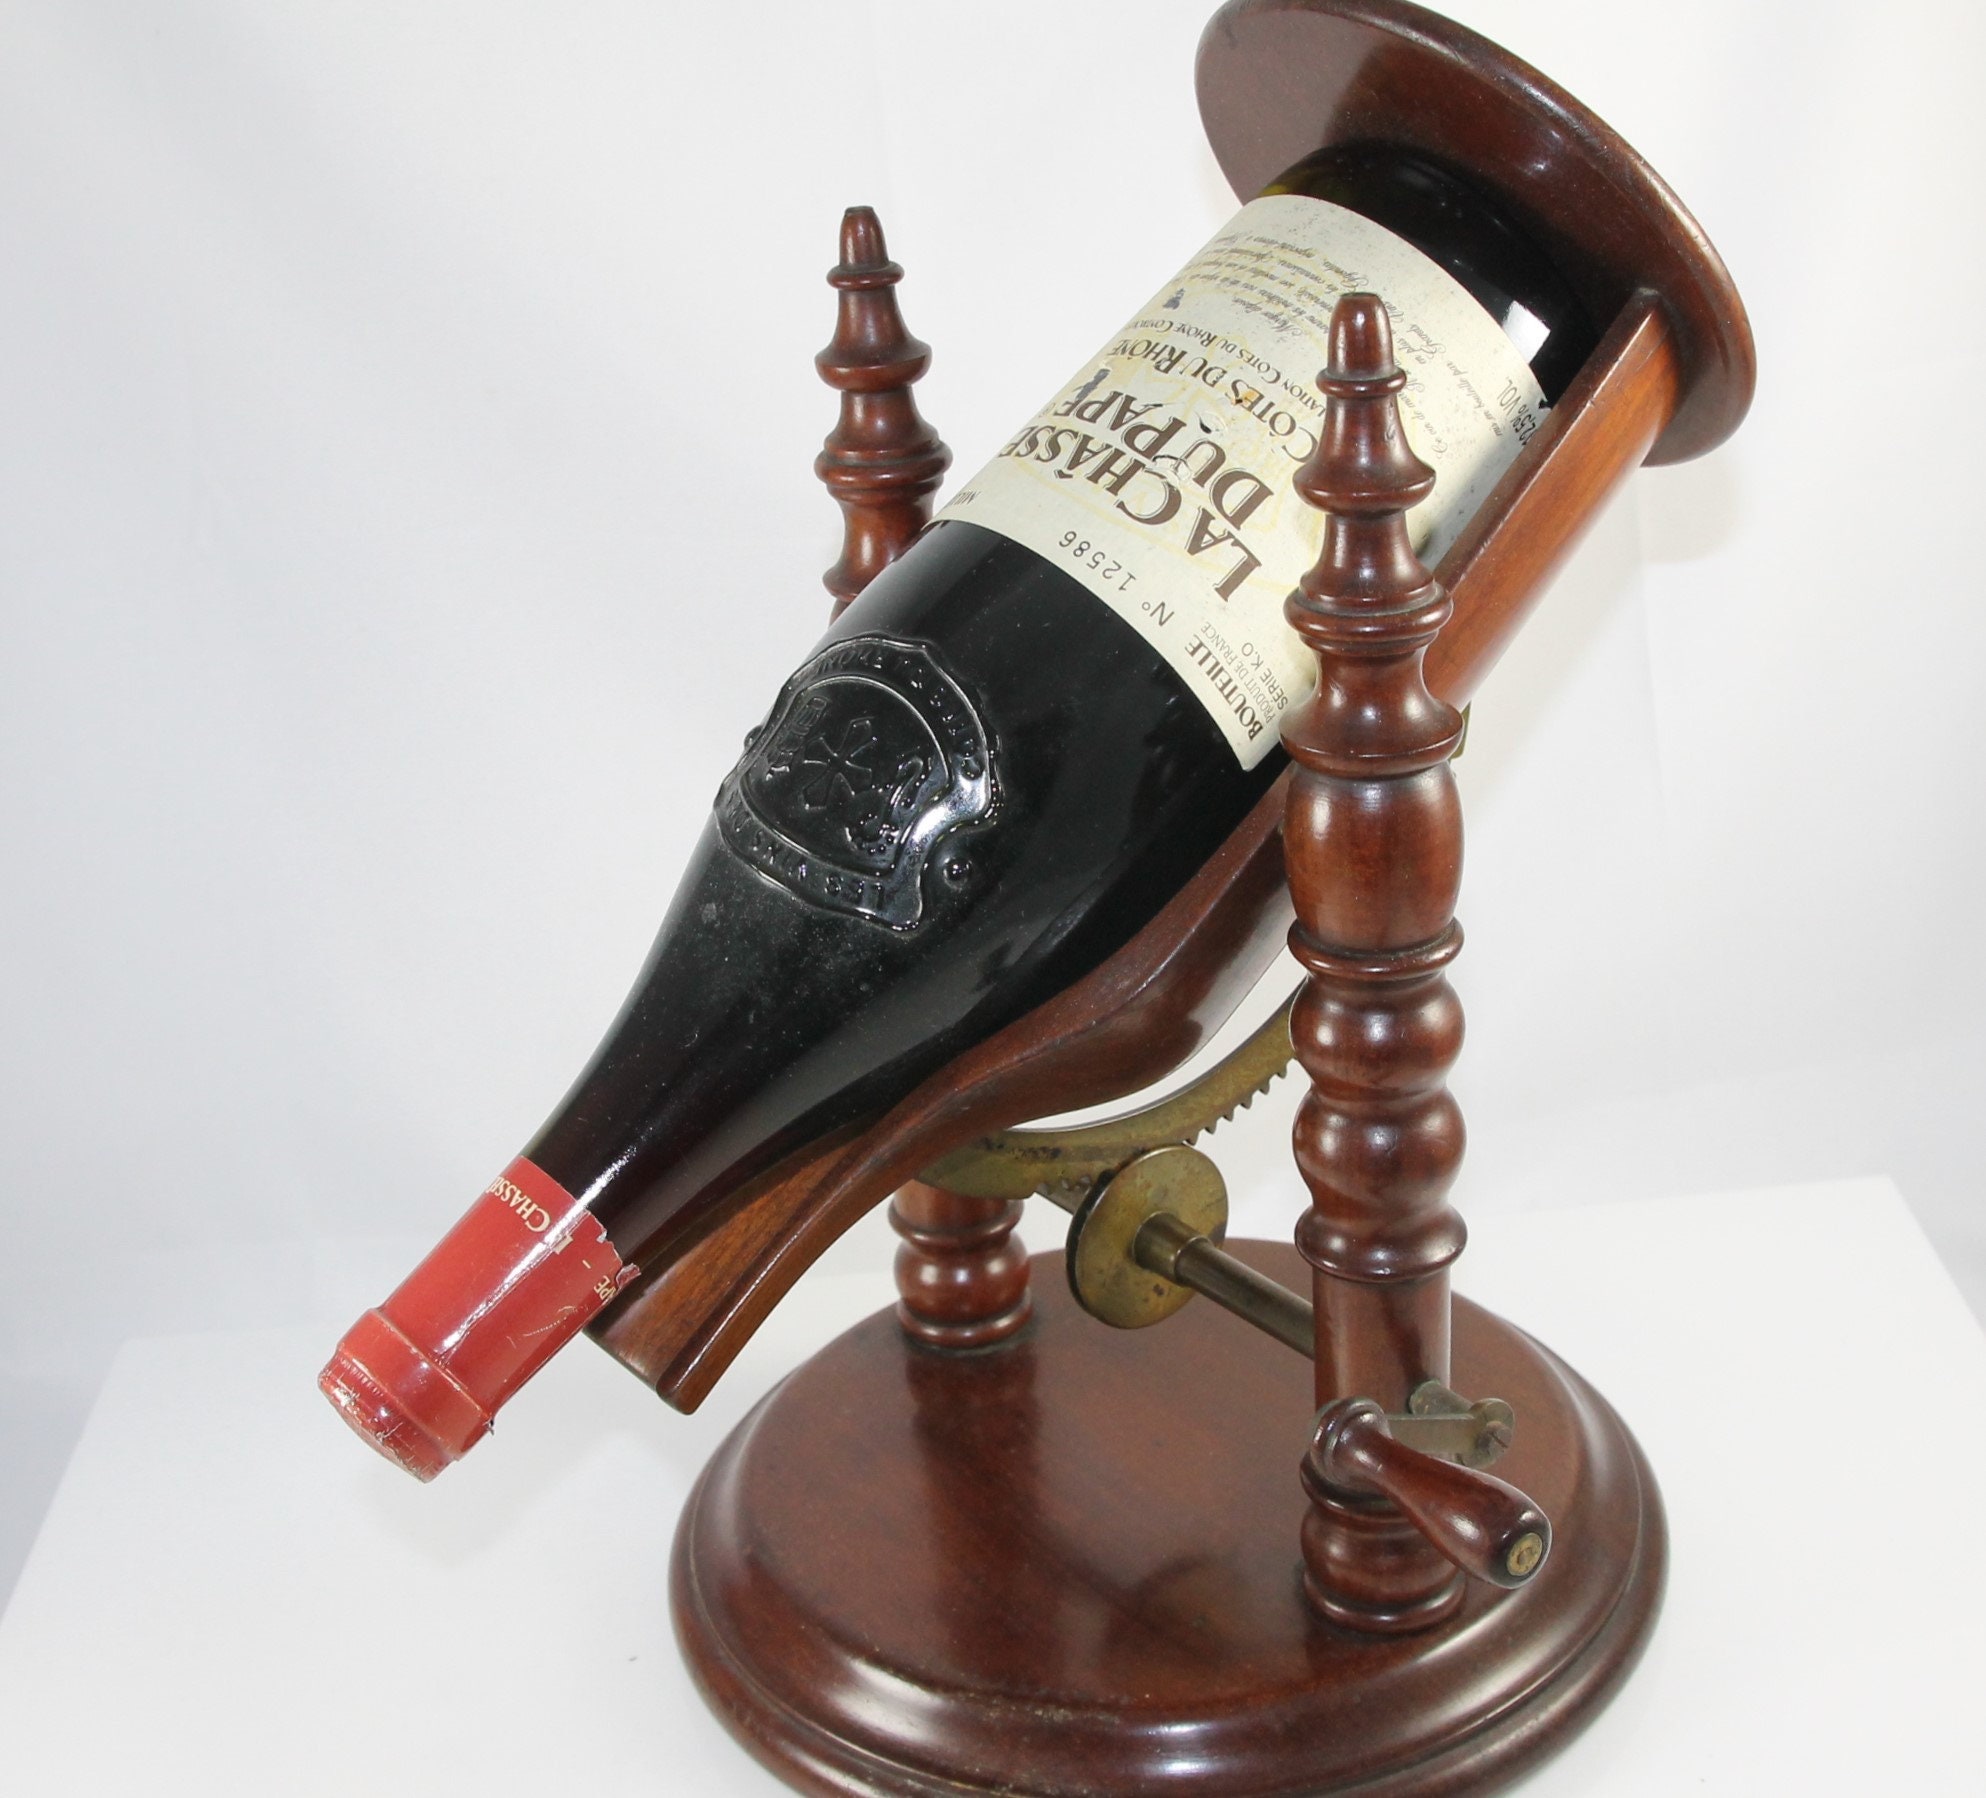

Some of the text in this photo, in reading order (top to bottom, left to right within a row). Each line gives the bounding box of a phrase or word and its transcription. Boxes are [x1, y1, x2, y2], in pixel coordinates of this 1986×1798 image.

[1107, 338, 1315, 460] CÔTES DU RHÔNE
[1281, 378, 1325, 415] LATION
[1053, 383, 1274, 530] DU PAPE
[997, 418, 1262, 602] LA CHÂSSE
[1056, 527, 1136, 590] 12586
[1183, 633, 1264, 741] BOUTEILLE
[1199, 620, 1276, 723] PRODUIT DE FRANCE
[1239, 640, 1289, 710] SÉRIE K.O
